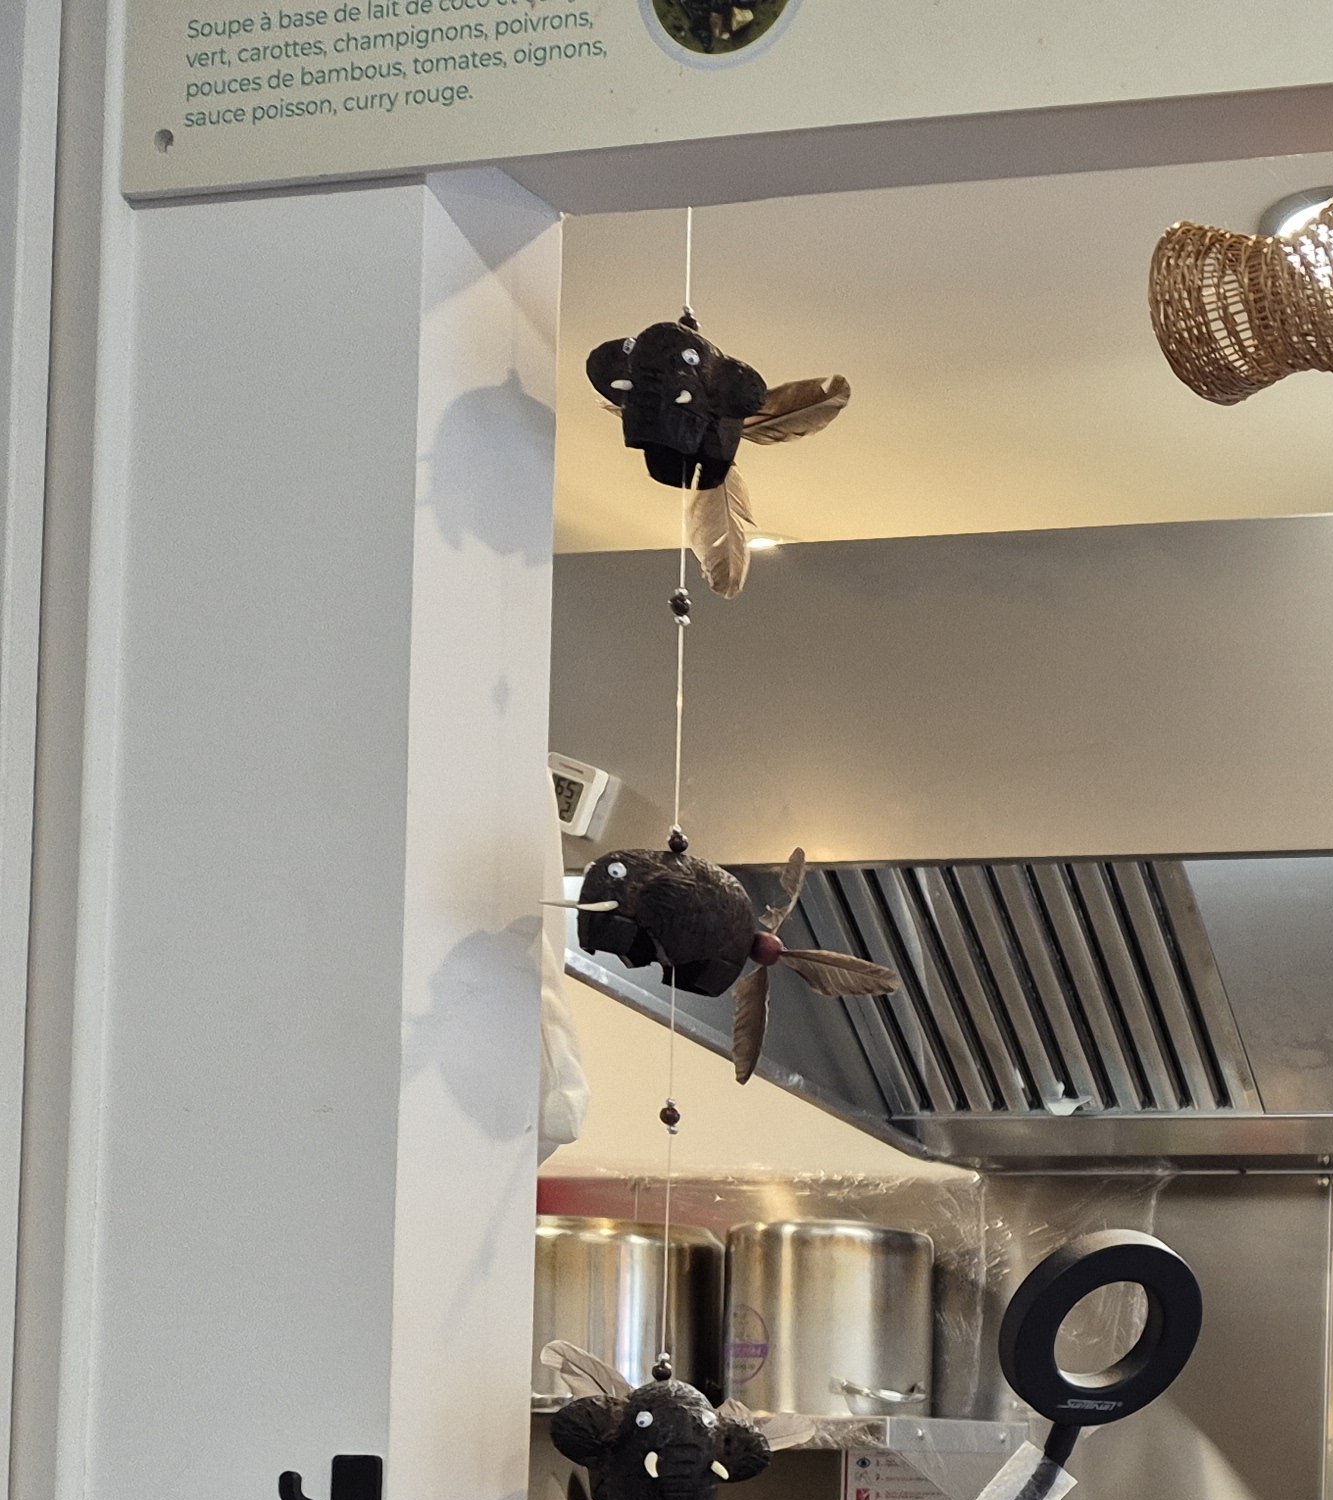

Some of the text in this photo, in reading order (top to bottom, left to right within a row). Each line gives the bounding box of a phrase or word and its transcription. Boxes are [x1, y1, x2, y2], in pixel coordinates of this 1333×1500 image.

[186, 10, 593, 68] vert, carottes, champignons, poivrons,
[187, 17, 254, 39] Soupe
[260, 12, 272, 31] à
[279, 9, 328, 29] base
[334, 3, 361, 23] de
[368, 0, 399, 20] lait
[186, 40, 608, 101] pouces de bambous, tomates, oignons,
[184, 84, 473, 127] sauce poisson, curry rouge.
